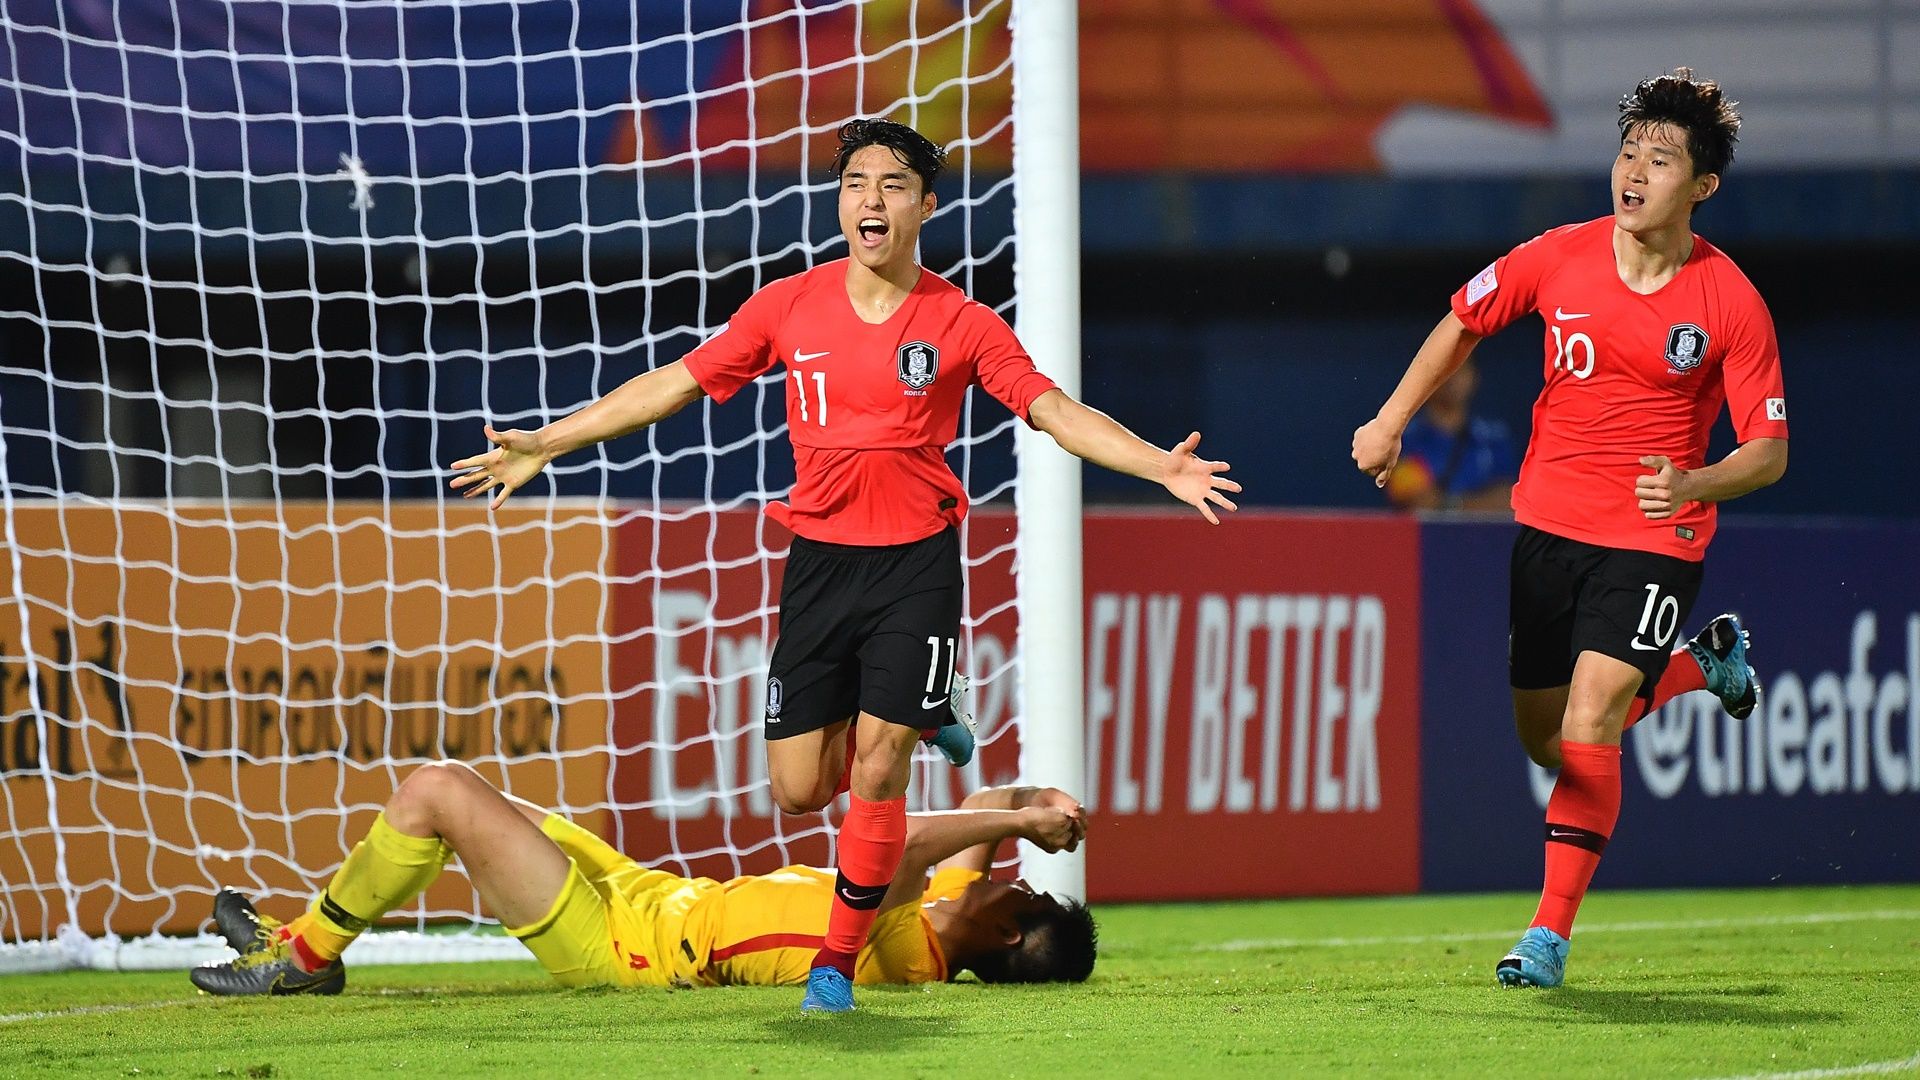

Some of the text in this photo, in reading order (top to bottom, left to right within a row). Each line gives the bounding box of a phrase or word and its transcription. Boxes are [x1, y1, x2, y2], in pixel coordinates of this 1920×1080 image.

[1551, 325, 1596, 380] 10
[792, 369, 828, 427] 11
[1637, 583, 1680, 648] 10
[925, 635, 955, 694] 11
[1086, 593, 1182, 815] FLY
[1187, 593, 1386, 815] BETTER
